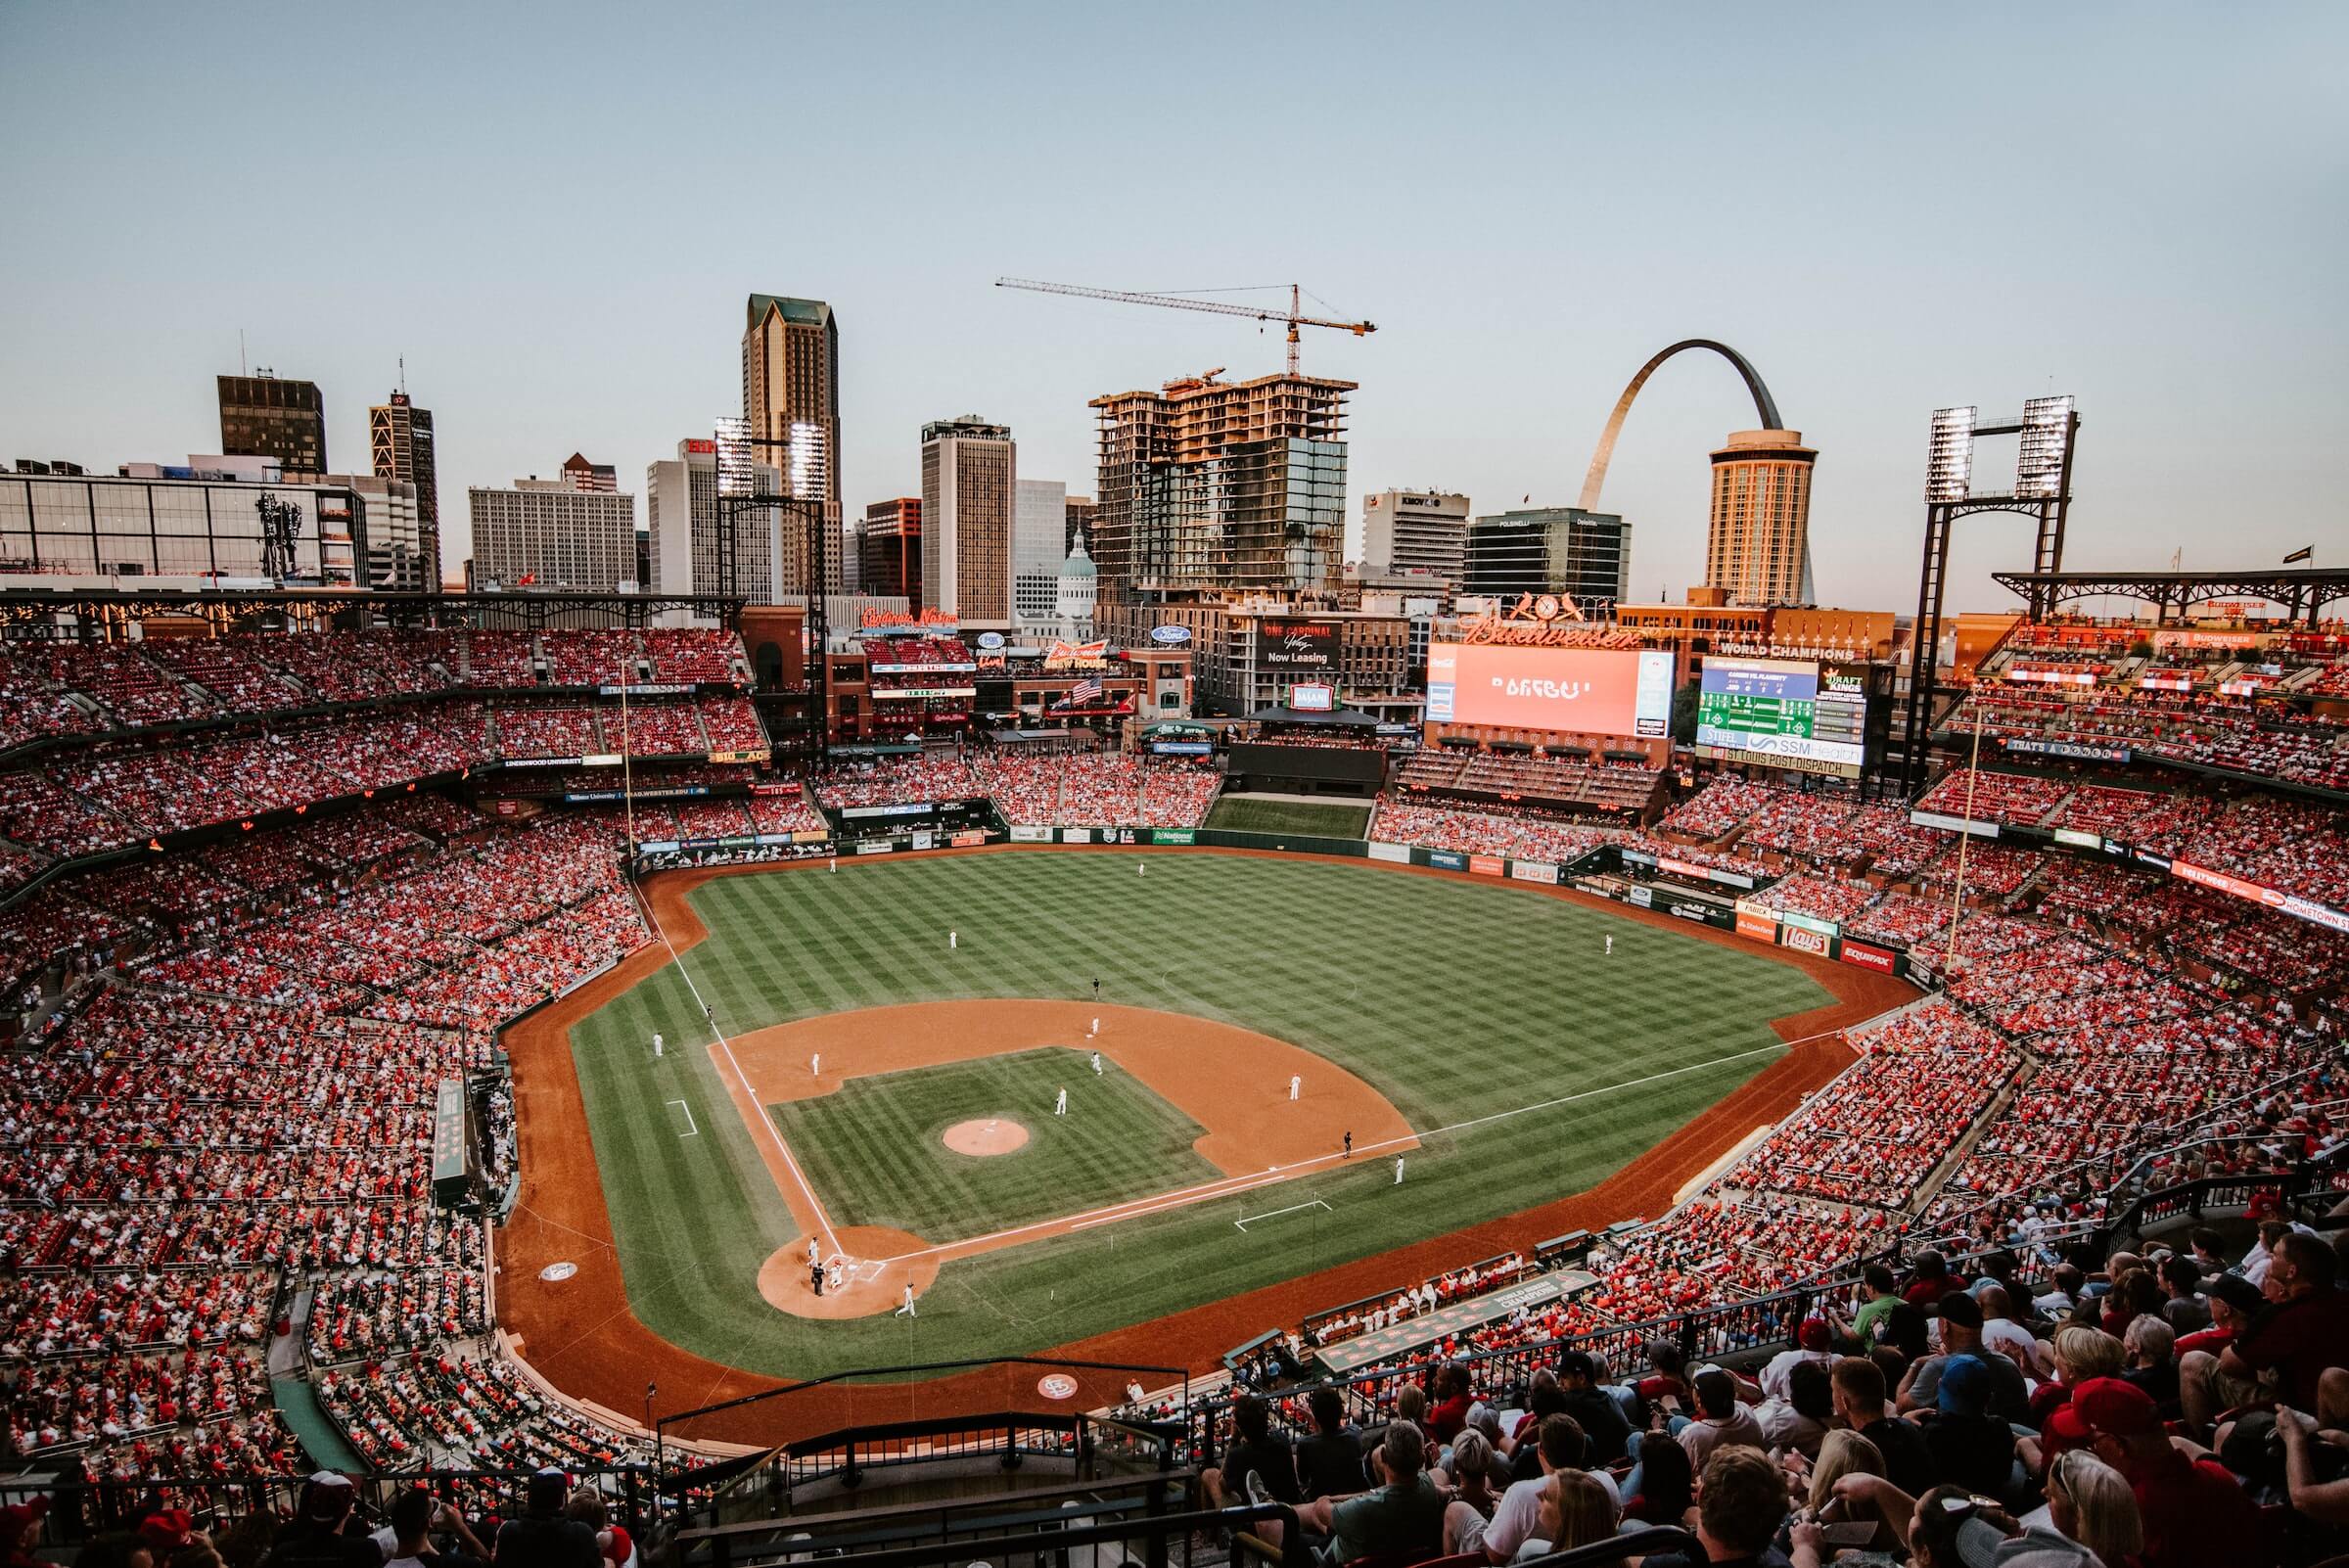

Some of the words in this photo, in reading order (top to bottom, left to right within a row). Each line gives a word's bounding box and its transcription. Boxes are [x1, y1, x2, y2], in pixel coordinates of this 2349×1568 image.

[1402, 497, 1425, 506] KMOV
[862, 607, 914, 627] Cardinals
[915, 606, 959, 627] Nation
[1159, 627, 1184, 640] Ford
[1265, 626, 1284, 637] ONE
[1286, 626, 1332, 637] CARDINAL
[1457, 613, 1642, 648] Budweiser
[1284, 632, 1313, 651] Way
[2193, 633, 2250, 643] BUDWEISER
[1050, 646, 1105, 658] Budweiser
[1721, 642, 1768, 656] WORLD
[1770, 646, 1854, 660] CHAMPIONS
[978, 657, 1005, 668] Live!
[1045, 660, 1072, 669] BREW
[1077, 659, 1107, 669] HOUSE
[1268, 652, 1290, 662] Now
[1291, 652, 1328, 664] Leasing
[1826, 675, 1863, 685] DRAFT
[1829, 683, 1862, 692] KINGS
[1295, 690, 1328, 705] DASANI
[2012, 739, 2044, 752] THAT'S
[2049, 744, 2056, 753] A
[715, 752, 736, 762] BIG
[1742, 751, 1767, 764] LOUIS
[1769, 754, 1842, 775] POST-DISPATCH
[2182, 867, 2229, 889] HOLLYWOOD
[1744, 905, 1768, 916] FABICK
[2286, 901, 2339, 924] HOMETOWN
[1844, 947, 1892, 967] EQUIFAX
[1494, 1290, 1525, 1303] WORLD
[1501, 1285, 1559, 1308] CHAMPIONS
